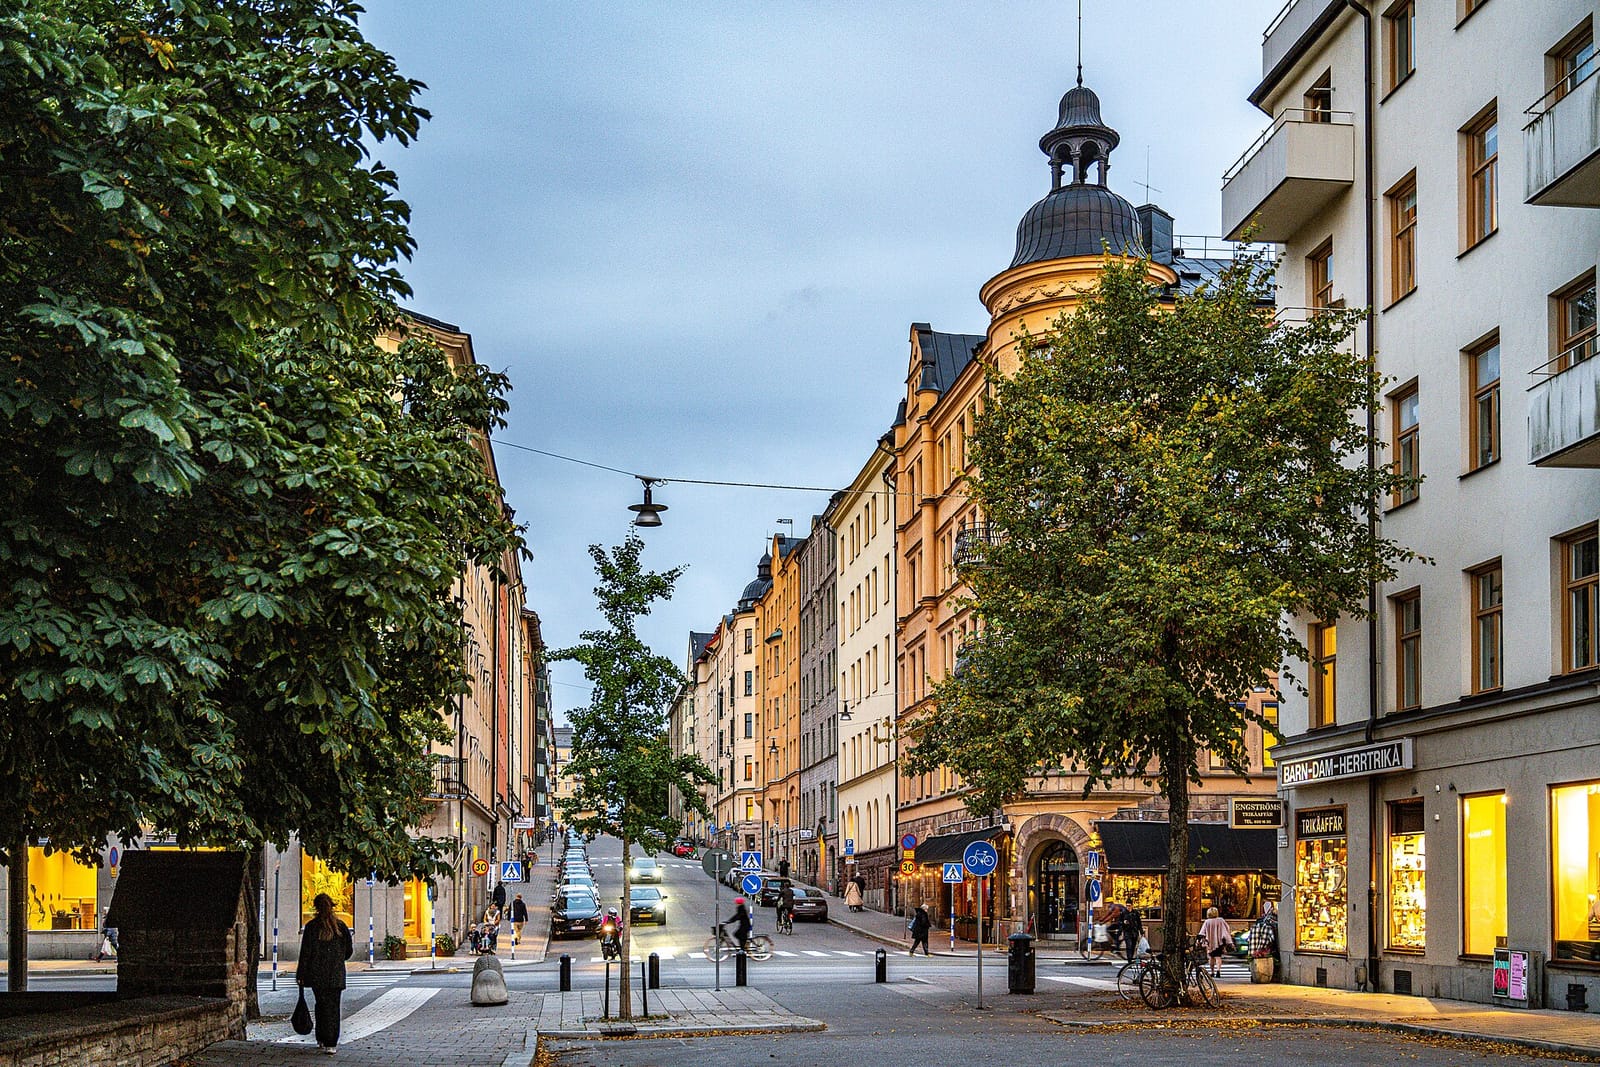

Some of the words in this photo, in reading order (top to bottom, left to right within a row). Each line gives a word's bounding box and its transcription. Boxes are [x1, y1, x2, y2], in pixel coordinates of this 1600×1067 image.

[1283, 744, 1400, 783] BARN-DAM-HERRTRIKÅ
[1235, 802, 1281, 811] ENGSTRÖMS
[1301, 815, 1343, 834] TRIKÅAFFÄR
[475, 863, 487, 871] 30
[902, 863, 914, 872] 30
